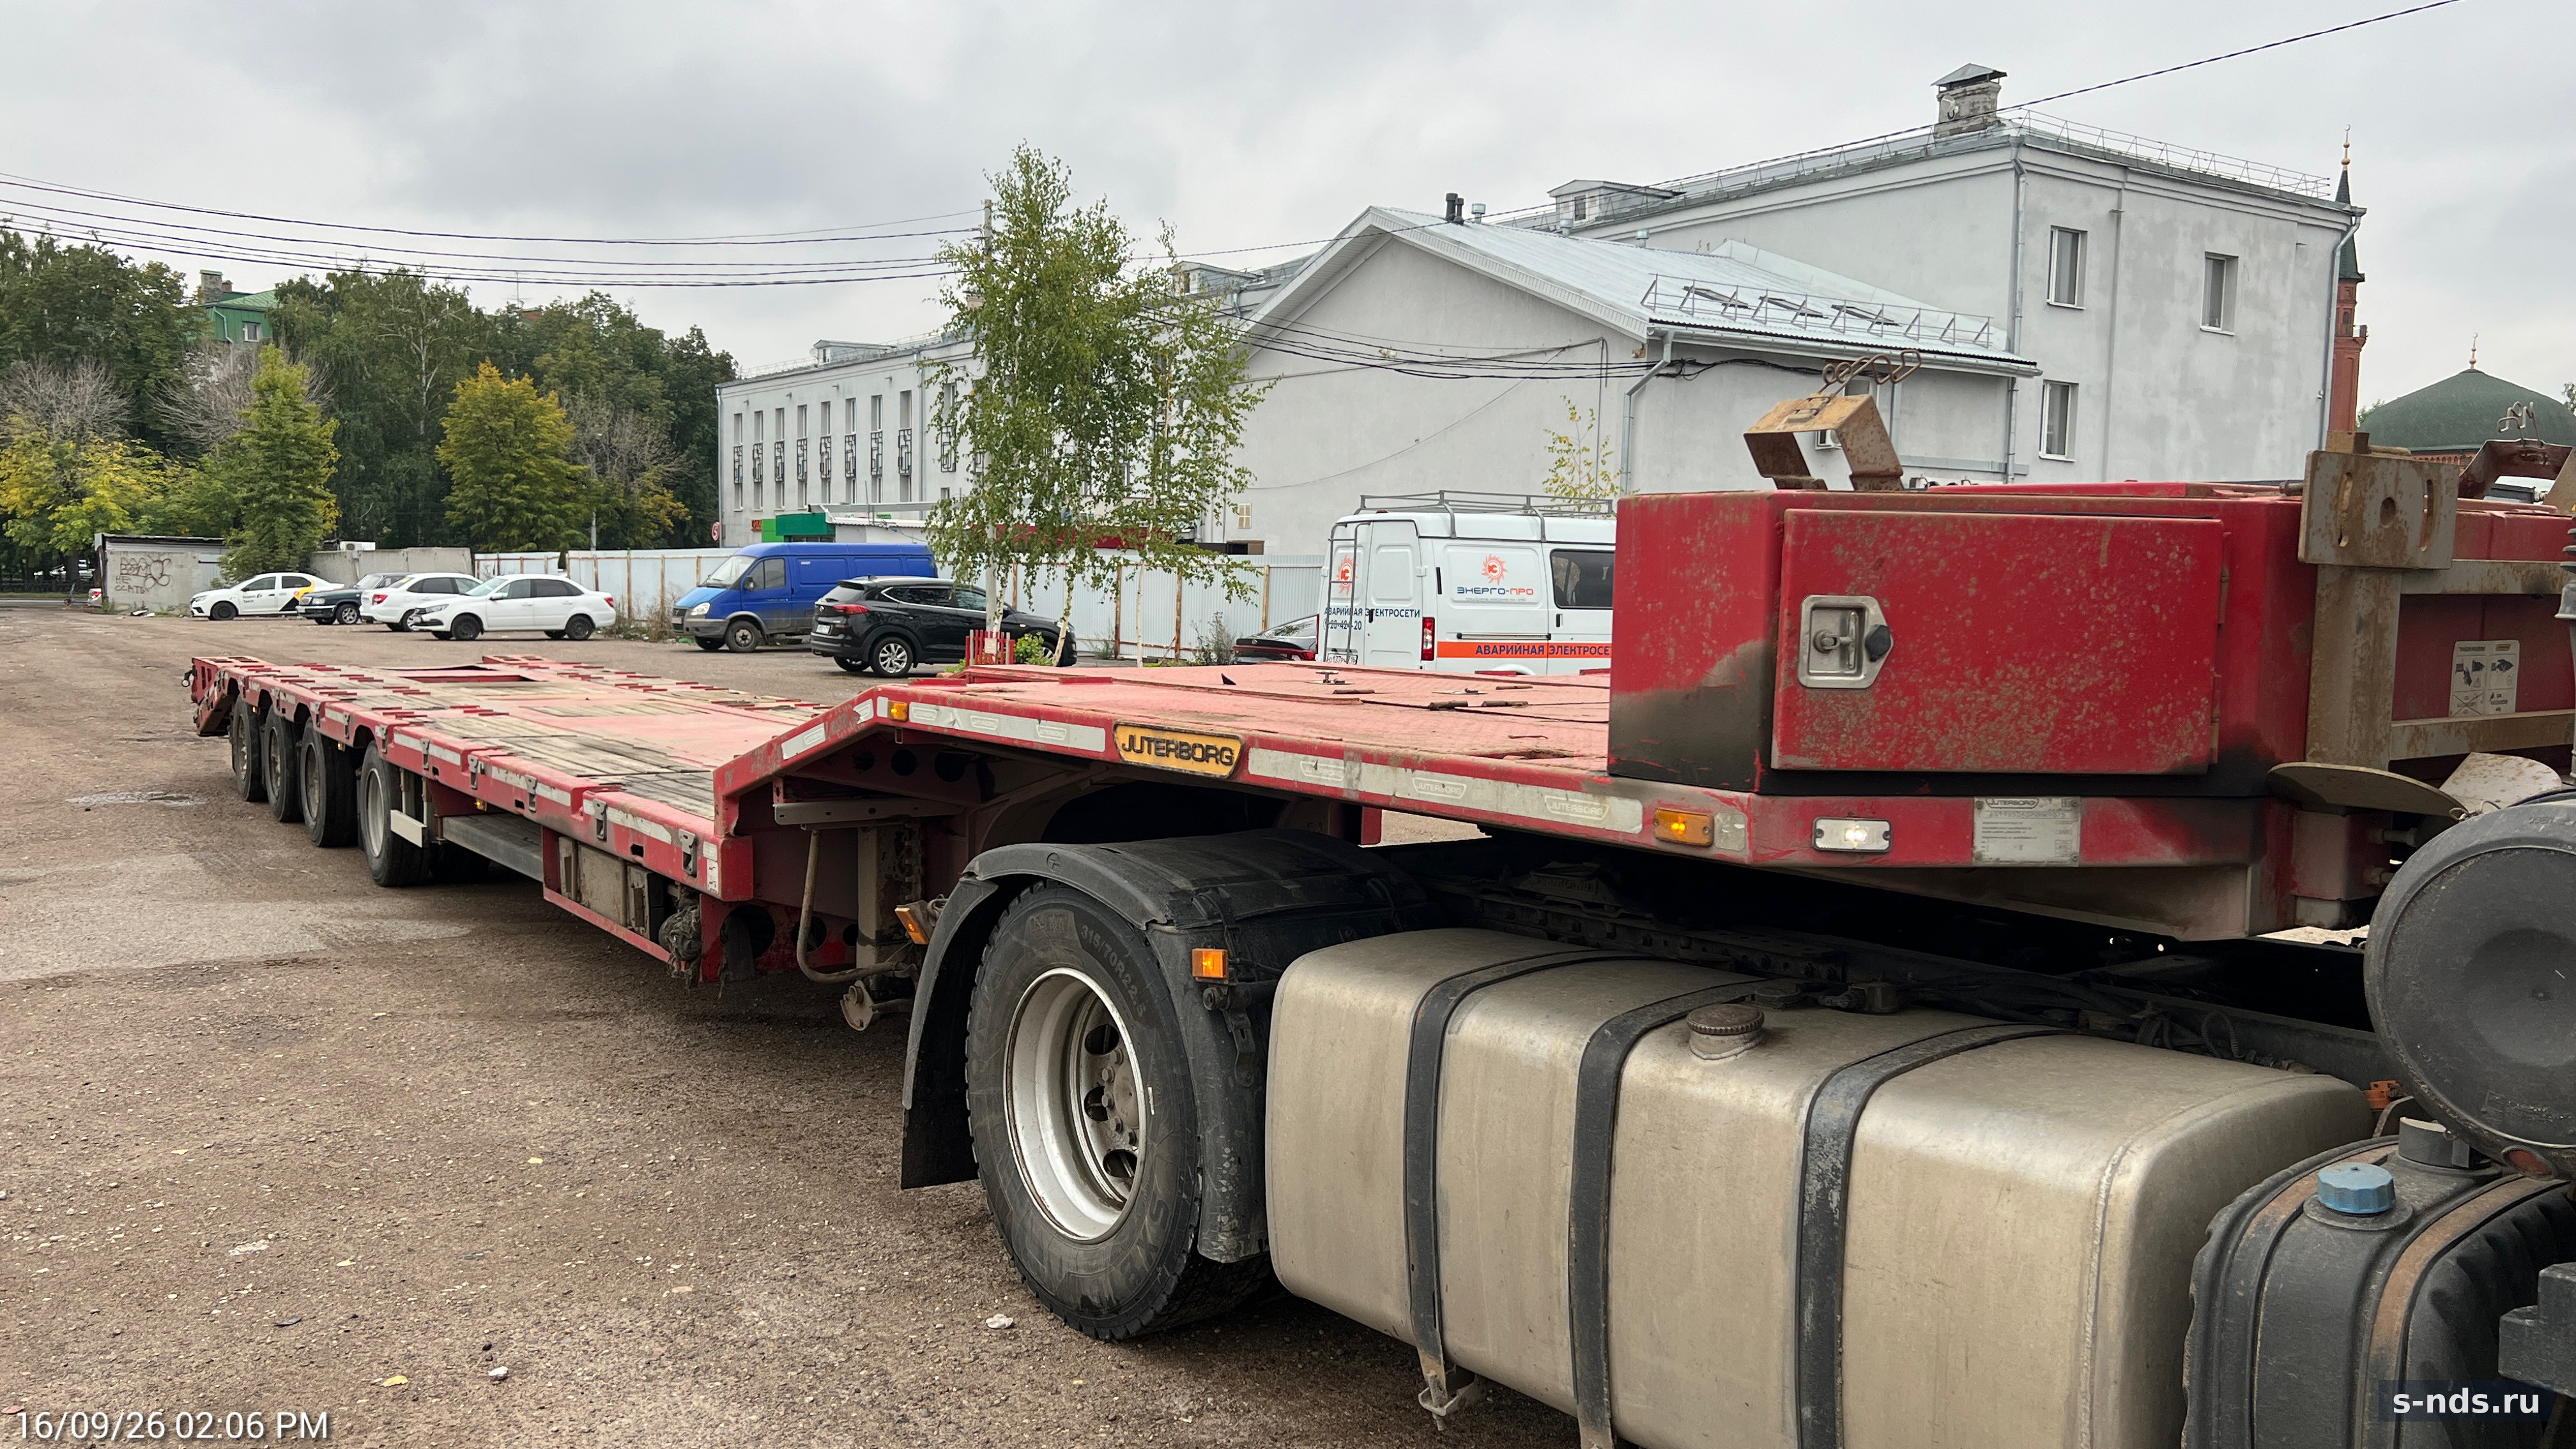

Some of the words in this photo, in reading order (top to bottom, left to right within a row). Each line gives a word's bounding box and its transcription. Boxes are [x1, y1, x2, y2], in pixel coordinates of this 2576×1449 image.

[1457, 586, 1533, 595] ЭНЕРГО-ПРО
[1475, 643, 1545, 656] АВАРИЙНАЯ
[1549, 645, 1612, 656] ЭЛЕКТРОСЕ
[1121, 734, 1234, 766] JUTERBORG
[1550, 801, 1603, 816] JUTERBORG
[1080, 924, 1147, 1017] 315/70R22.5
